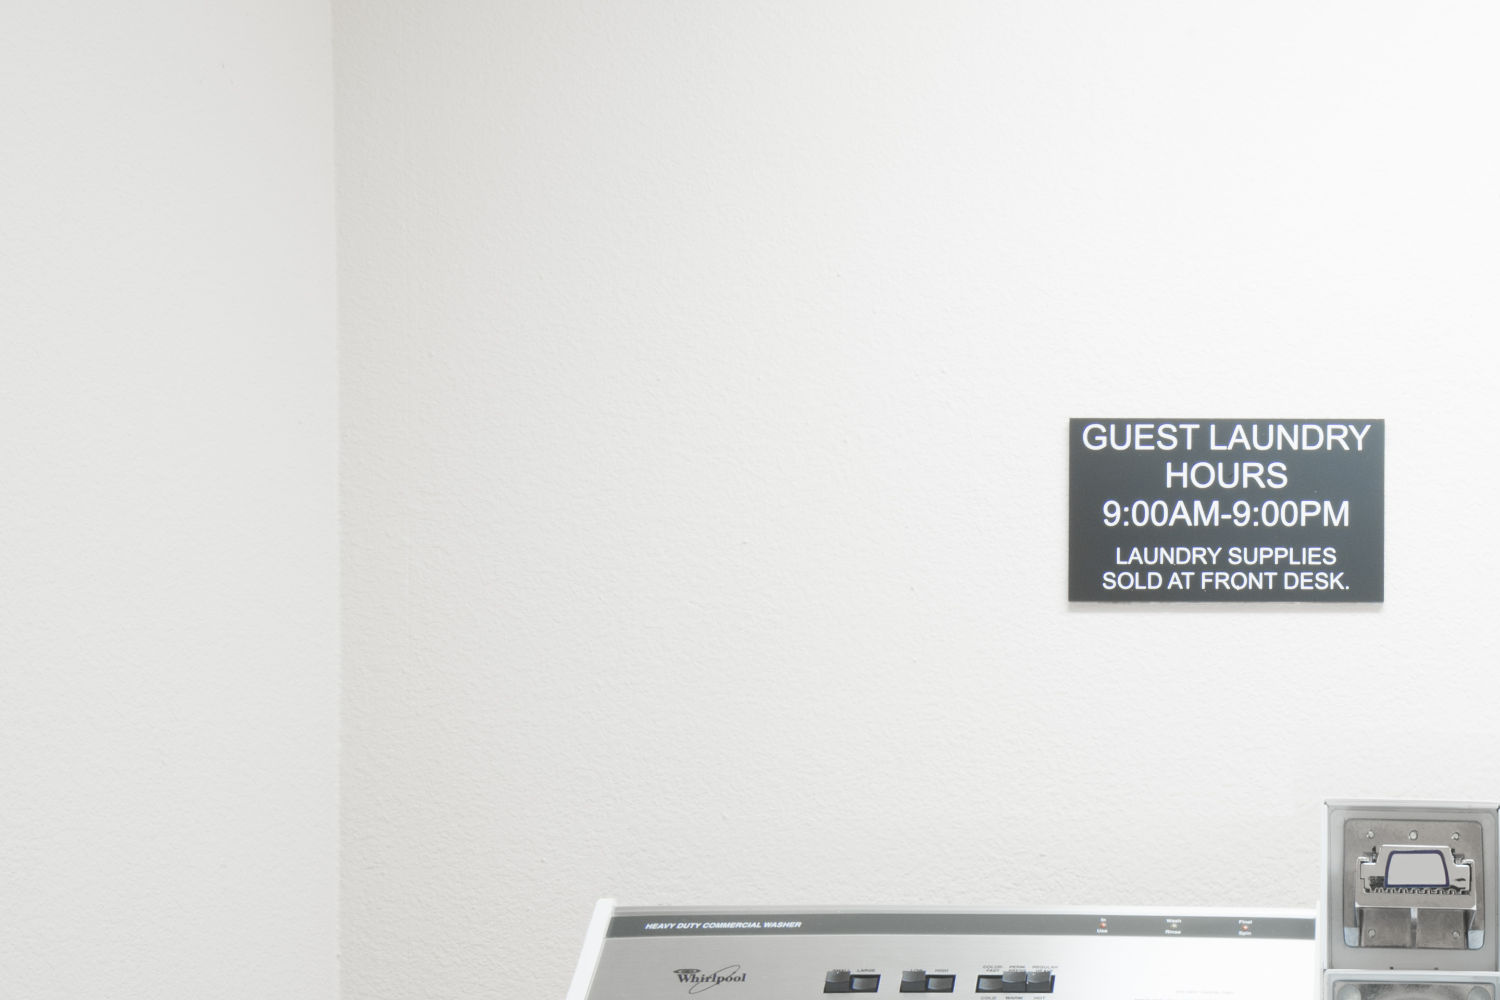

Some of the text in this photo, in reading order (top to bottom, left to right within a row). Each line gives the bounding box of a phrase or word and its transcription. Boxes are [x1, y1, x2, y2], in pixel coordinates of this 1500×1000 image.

[1082, 423, 1371, 451] GUEST LAUNDRY
[1166, 461, 1288, 489] HOURS
[1103, 500, 1350, 527] 9:00AM-9:00PM
[1116, 547, 1336, 565] LAUNDRY SUPPLIES
[1102, 572, 1350, 590] SOLD AT FRONT DESK.
[677, 973, 747, 985] Whirlpool
